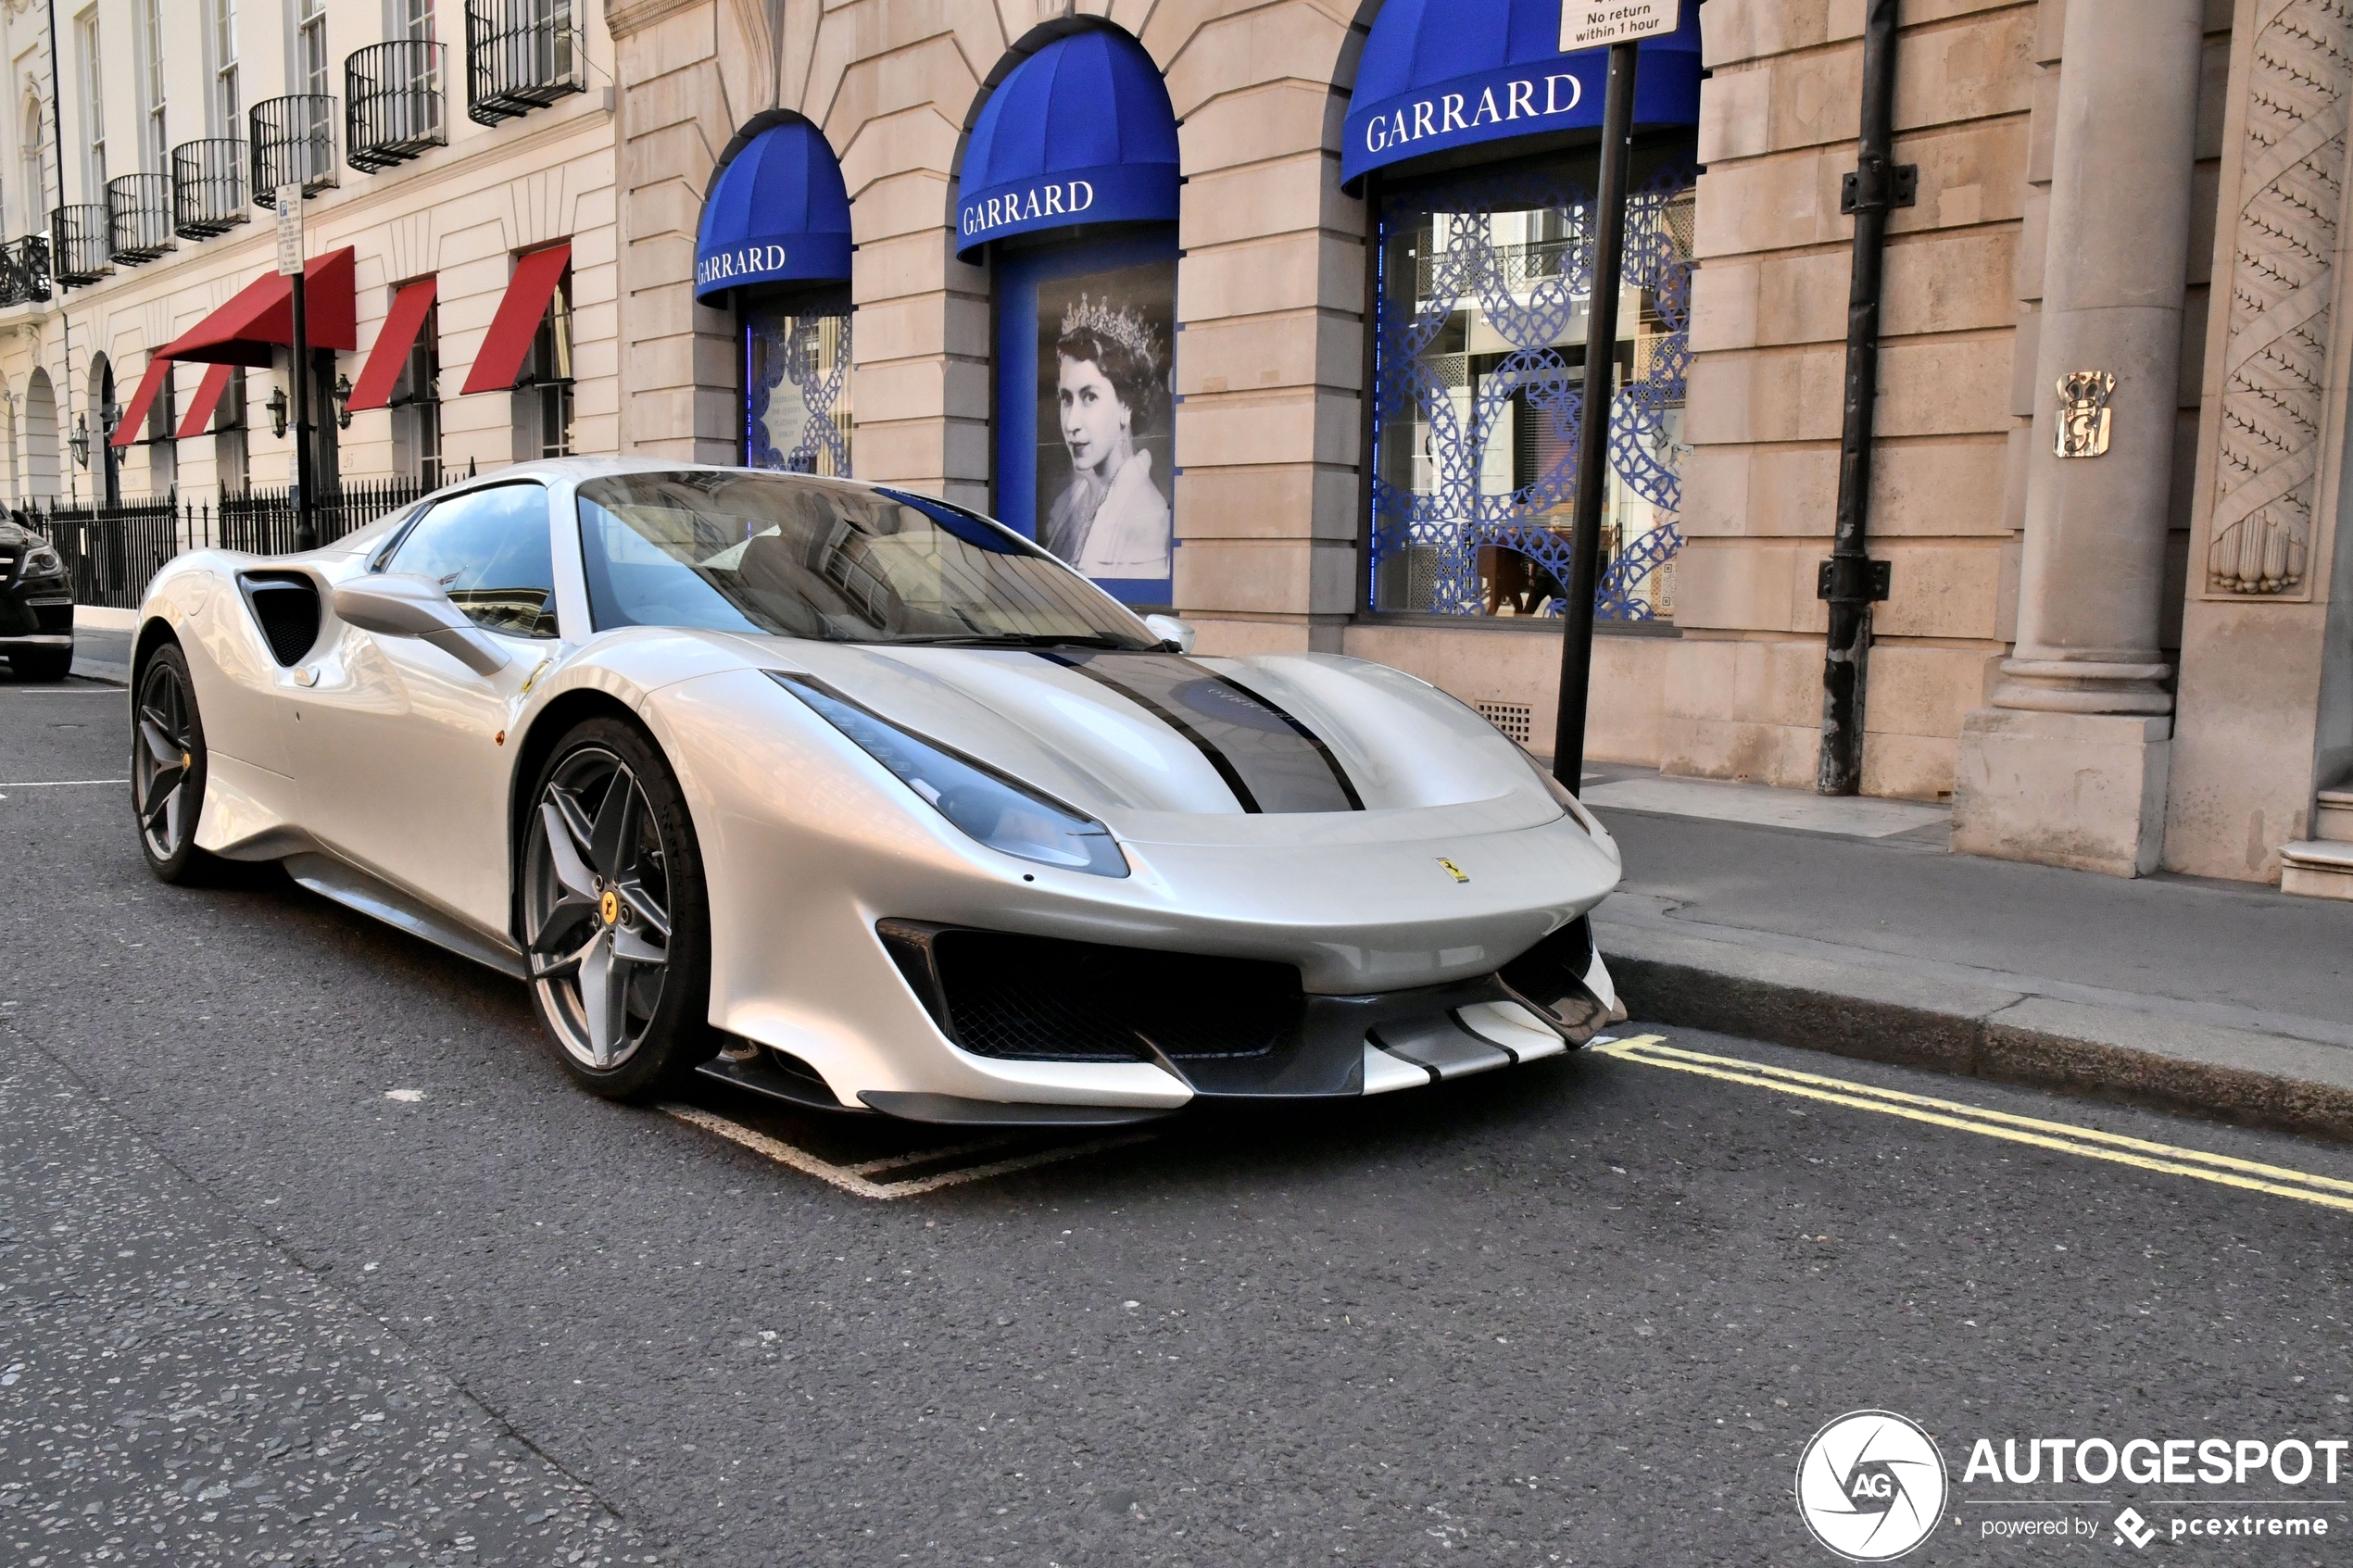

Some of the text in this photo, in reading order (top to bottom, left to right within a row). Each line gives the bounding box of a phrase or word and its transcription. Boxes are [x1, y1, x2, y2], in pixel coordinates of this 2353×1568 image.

[1576, 19, 1660, 42] within 1 hour
[1587, 5, 1651, 25] No return
[1366, 74, 1581, 153] GARRARD
[963, 181, 1093, 236] GARRARD
[698, 245, 786, 285] GARRARD
